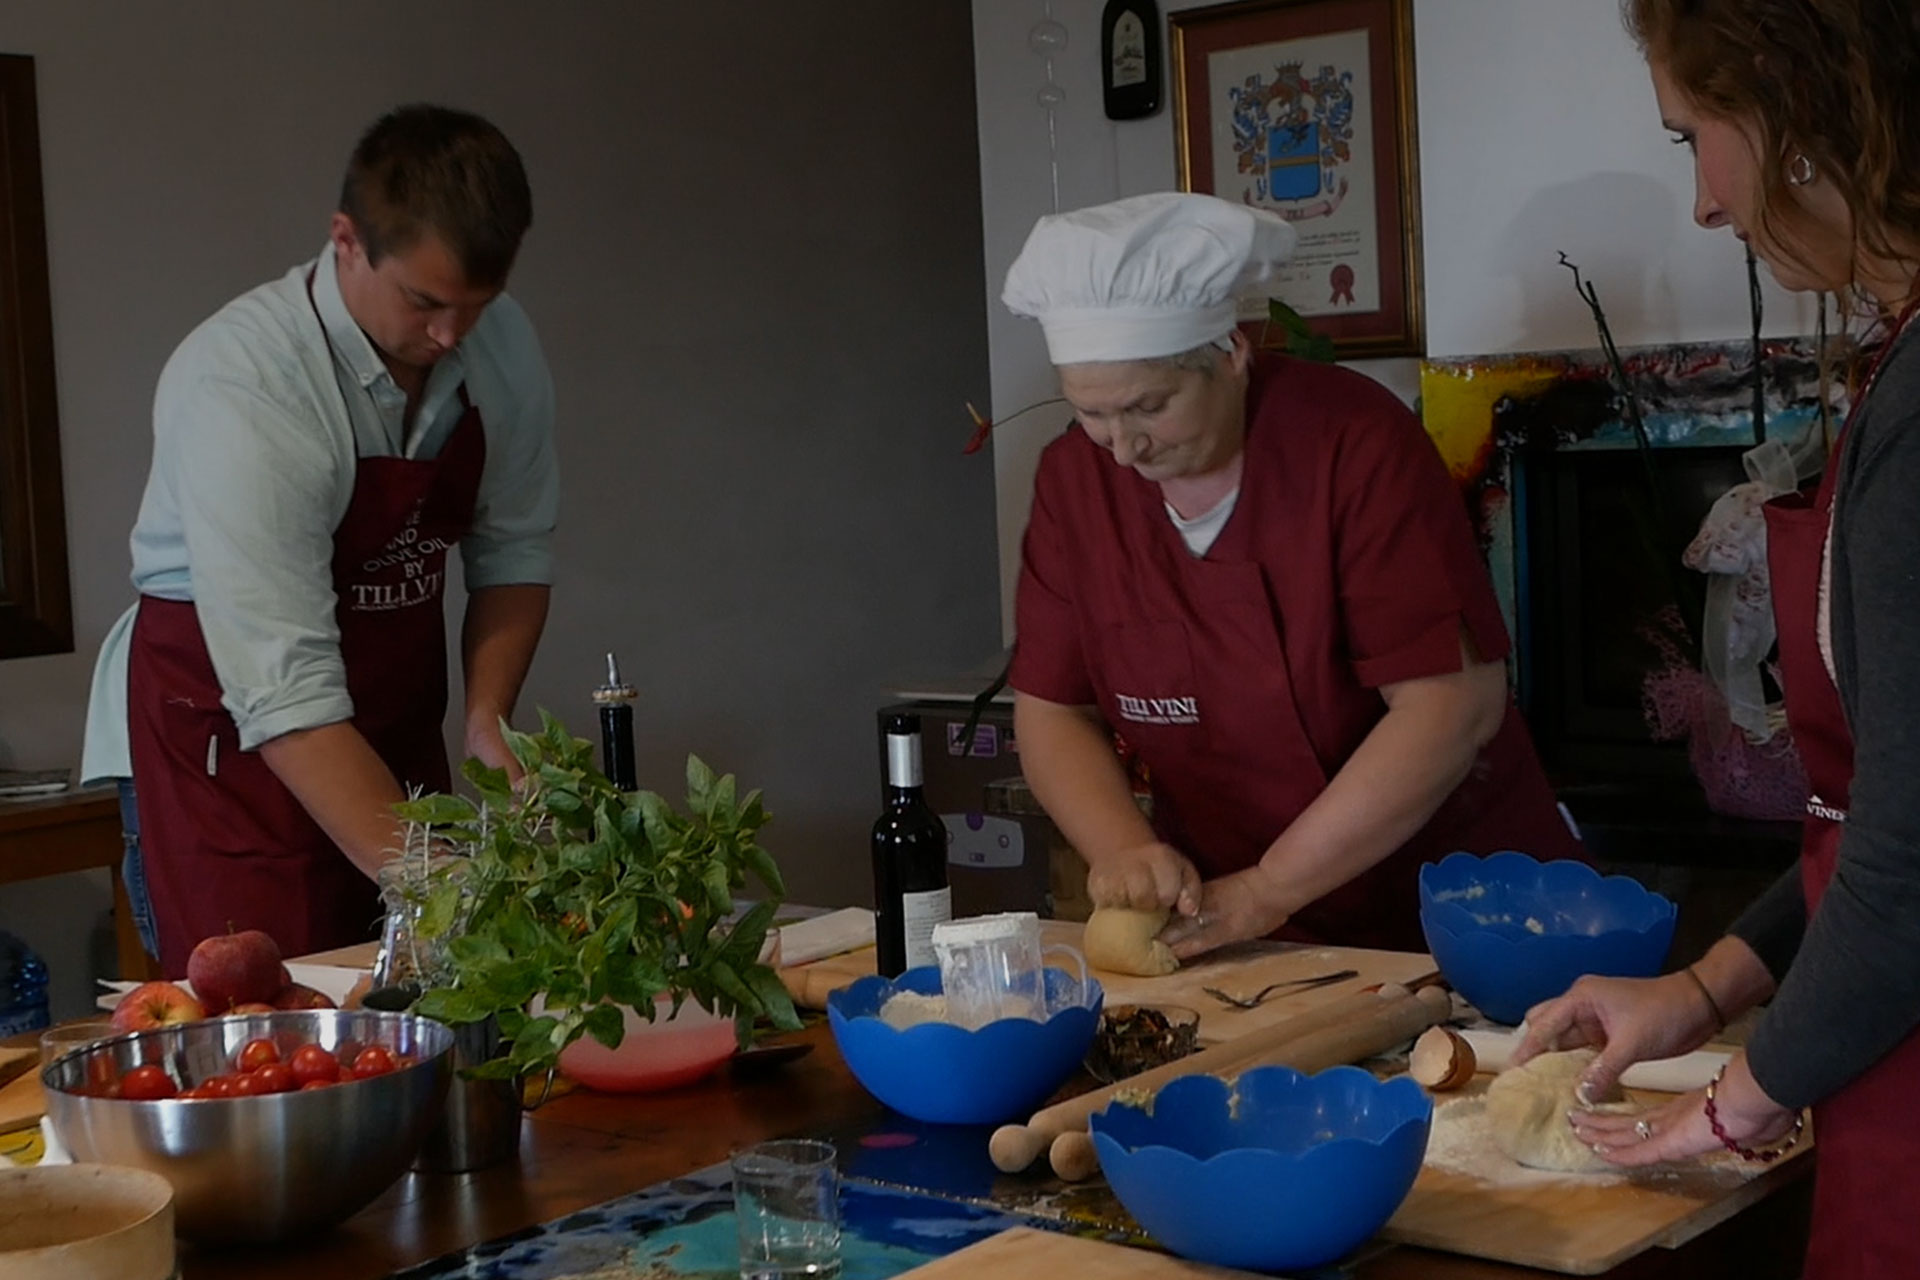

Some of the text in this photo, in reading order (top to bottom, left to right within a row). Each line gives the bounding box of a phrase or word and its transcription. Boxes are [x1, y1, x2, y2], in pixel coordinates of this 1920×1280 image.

[363, 537, 449, 572] OLIVE OIL
[404, 559, 425, 578] BY
[351, 582, 407, 605] TILI
[1150, 696, 1199, 715] VINI
